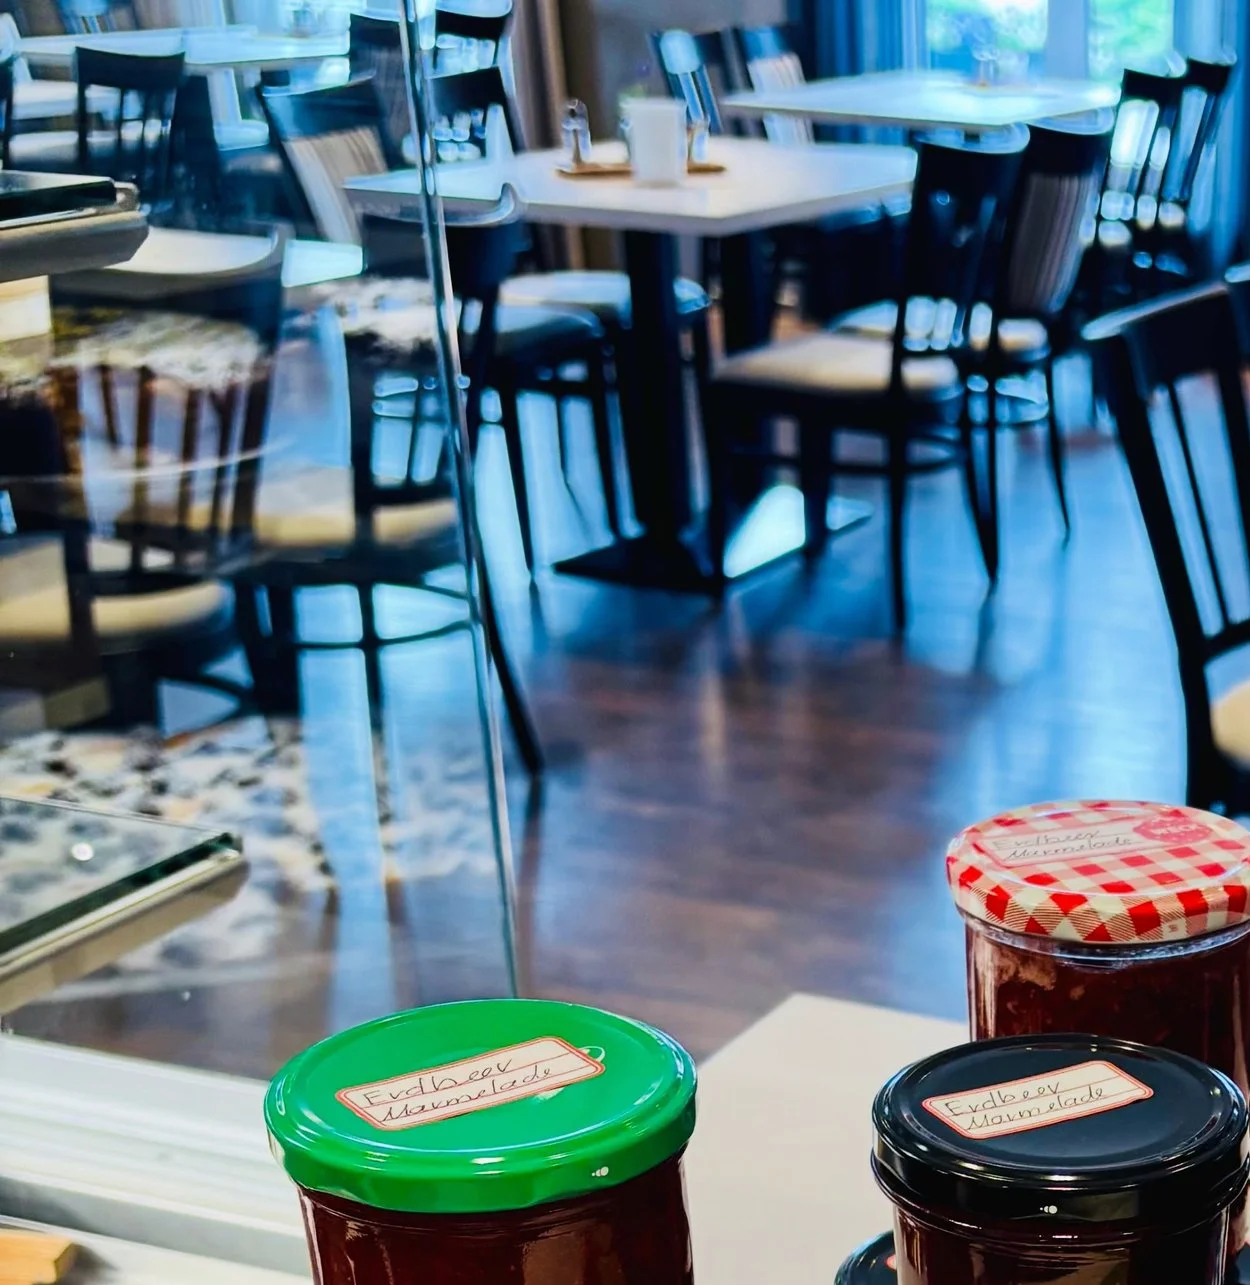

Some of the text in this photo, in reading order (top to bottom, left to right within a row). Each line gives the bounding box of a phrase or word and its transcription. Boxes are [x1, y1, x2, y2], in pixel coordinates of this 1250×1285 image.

[363, 1059, 513, 1107] Erdbeer
[945, 1081, 1060, 1116] Erdbeer
[967, 1085, 1104, 1130] Marmelade
